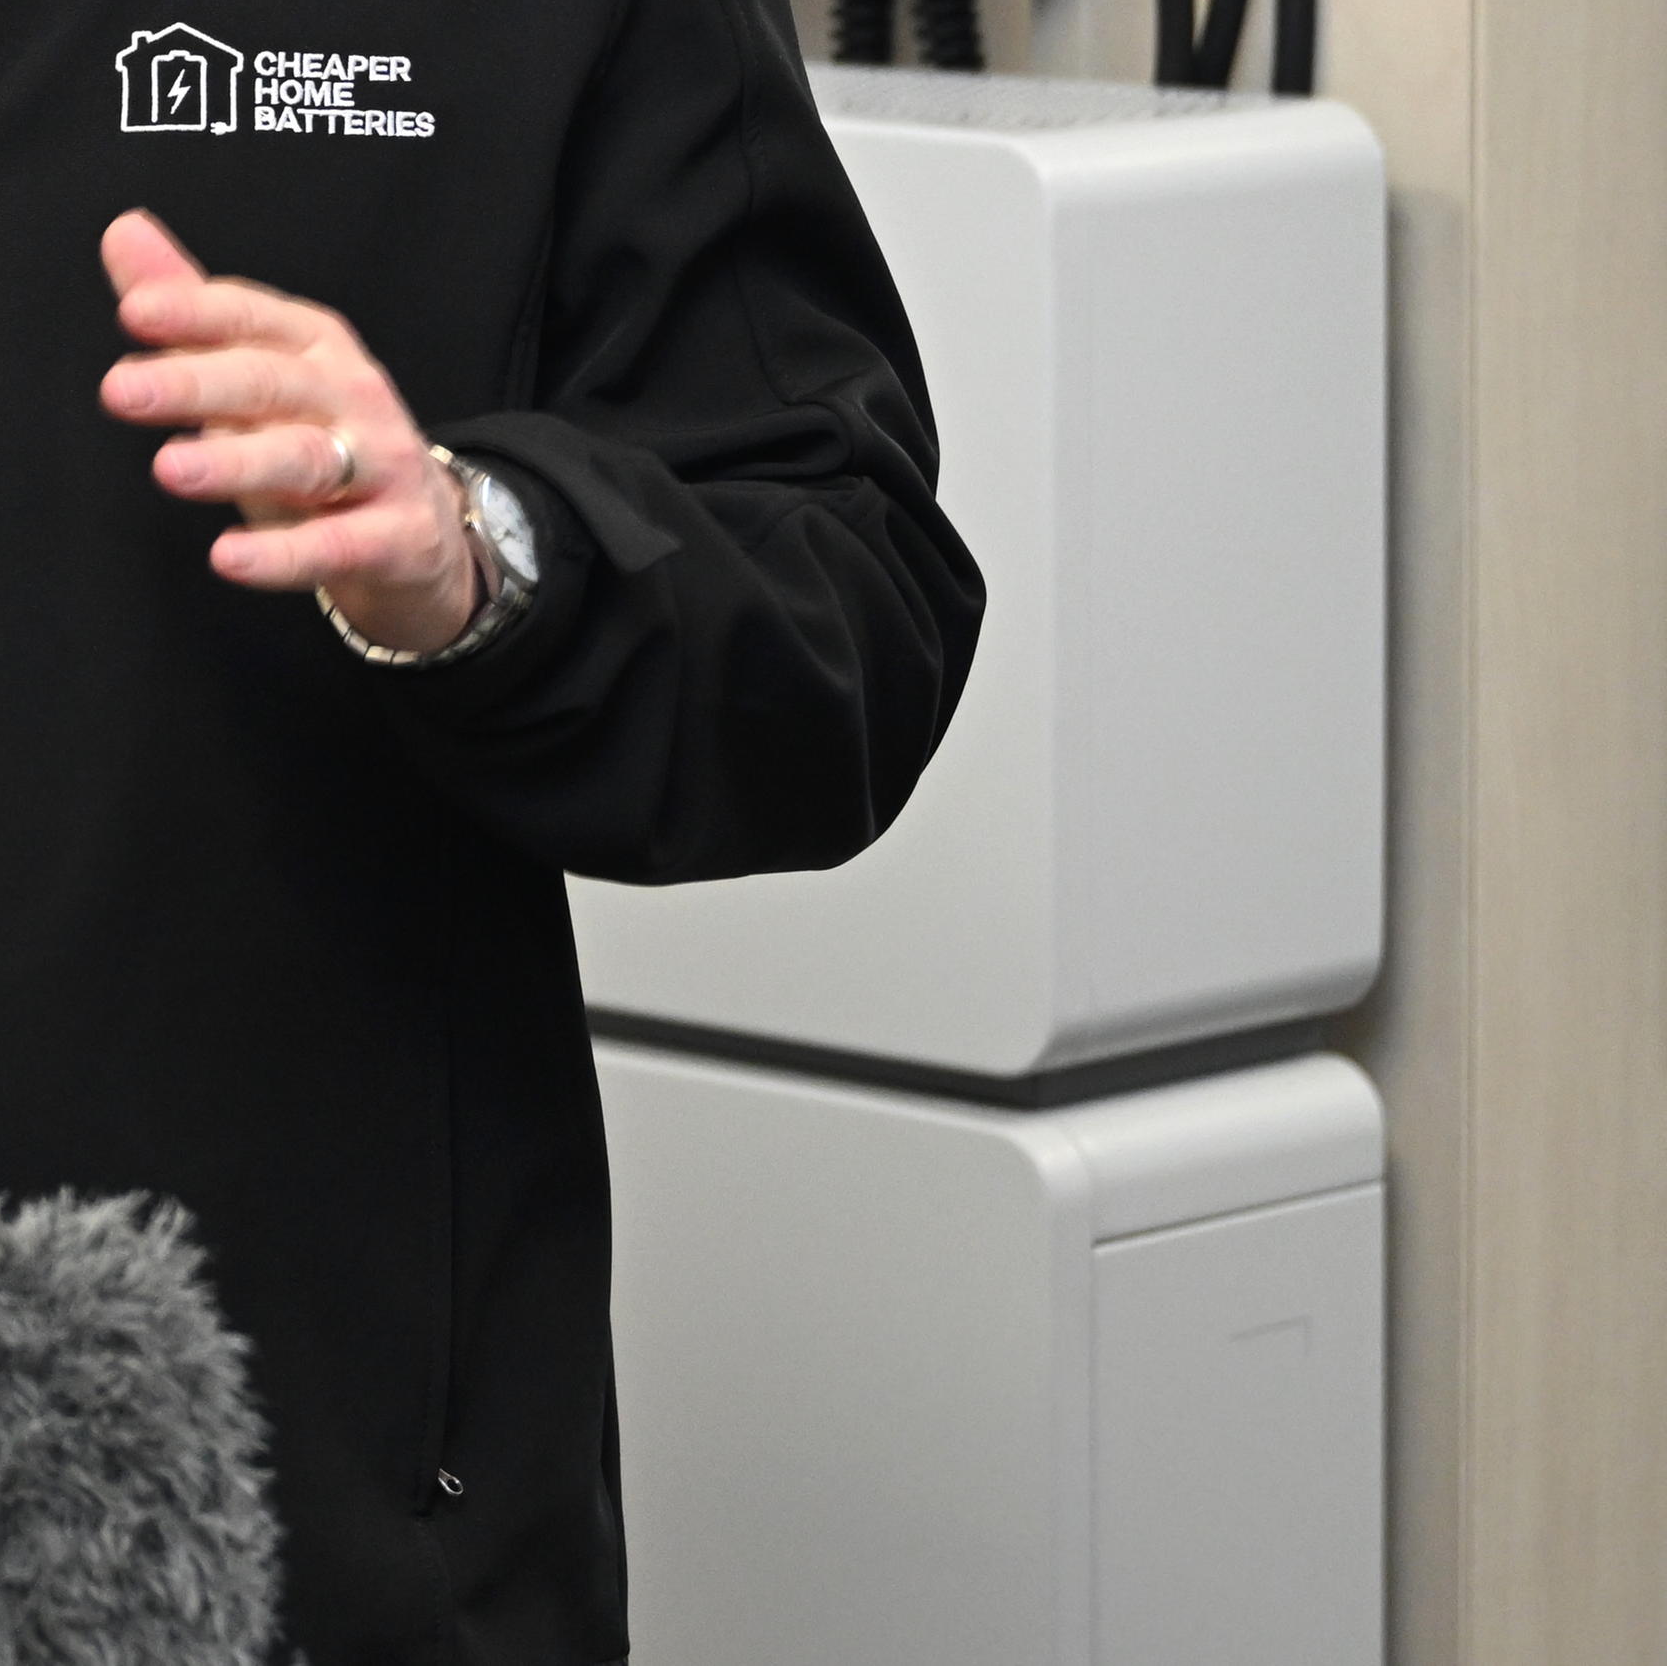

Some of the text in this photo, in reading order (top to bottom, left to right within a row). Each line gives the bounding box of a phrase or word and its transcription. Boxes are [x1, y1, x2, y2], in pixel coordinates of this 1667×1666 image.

[254, 50, 412, 81] CHEAPER
[254, 77, 356, 107] HOME
[254, 105, 436, 138] BATTERIES
